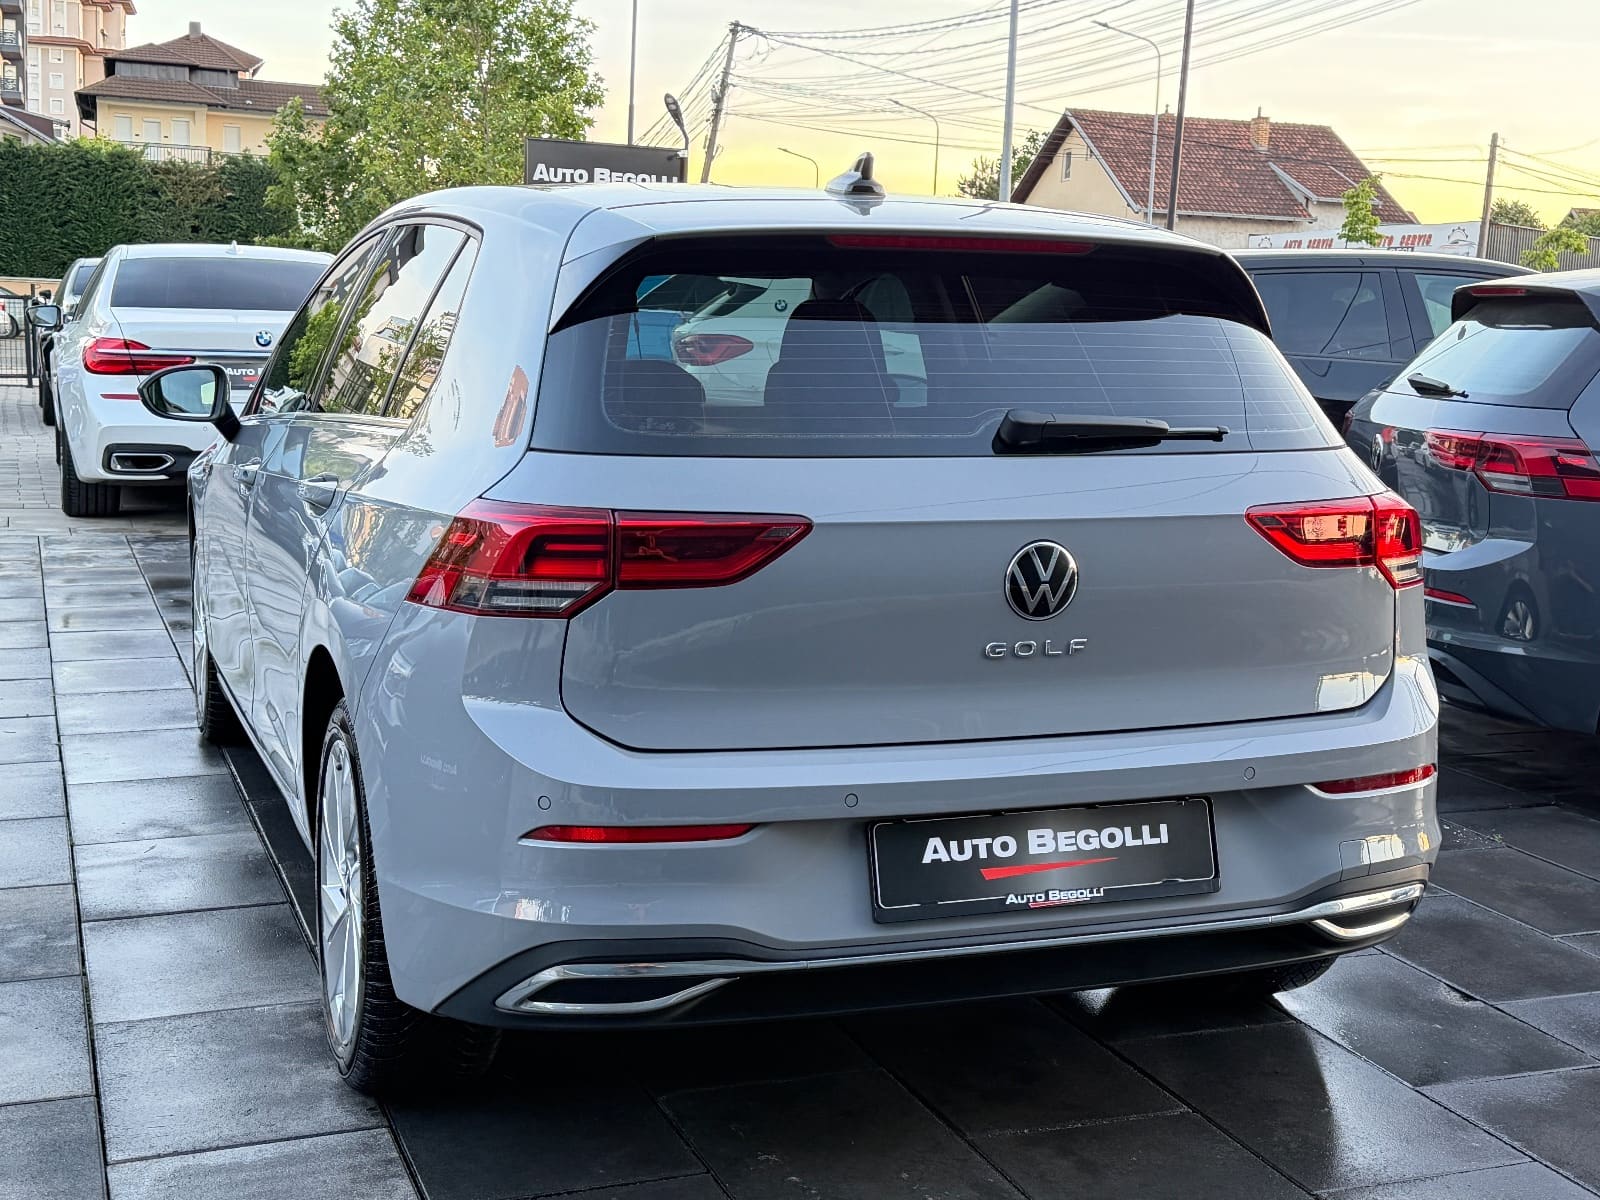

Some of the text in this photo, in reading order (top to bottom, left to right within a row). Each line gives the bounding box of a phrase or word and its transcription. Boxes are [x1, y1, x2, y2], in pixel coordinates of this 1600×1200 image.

[533, 163, 588, 183] AUTO
[985, 638, 1088, 657] GOLF
[921, 823, 1169, 864] AUTO BEGOLLI
[1005, 887, 1104, 905] AUTO BEGOLLI
